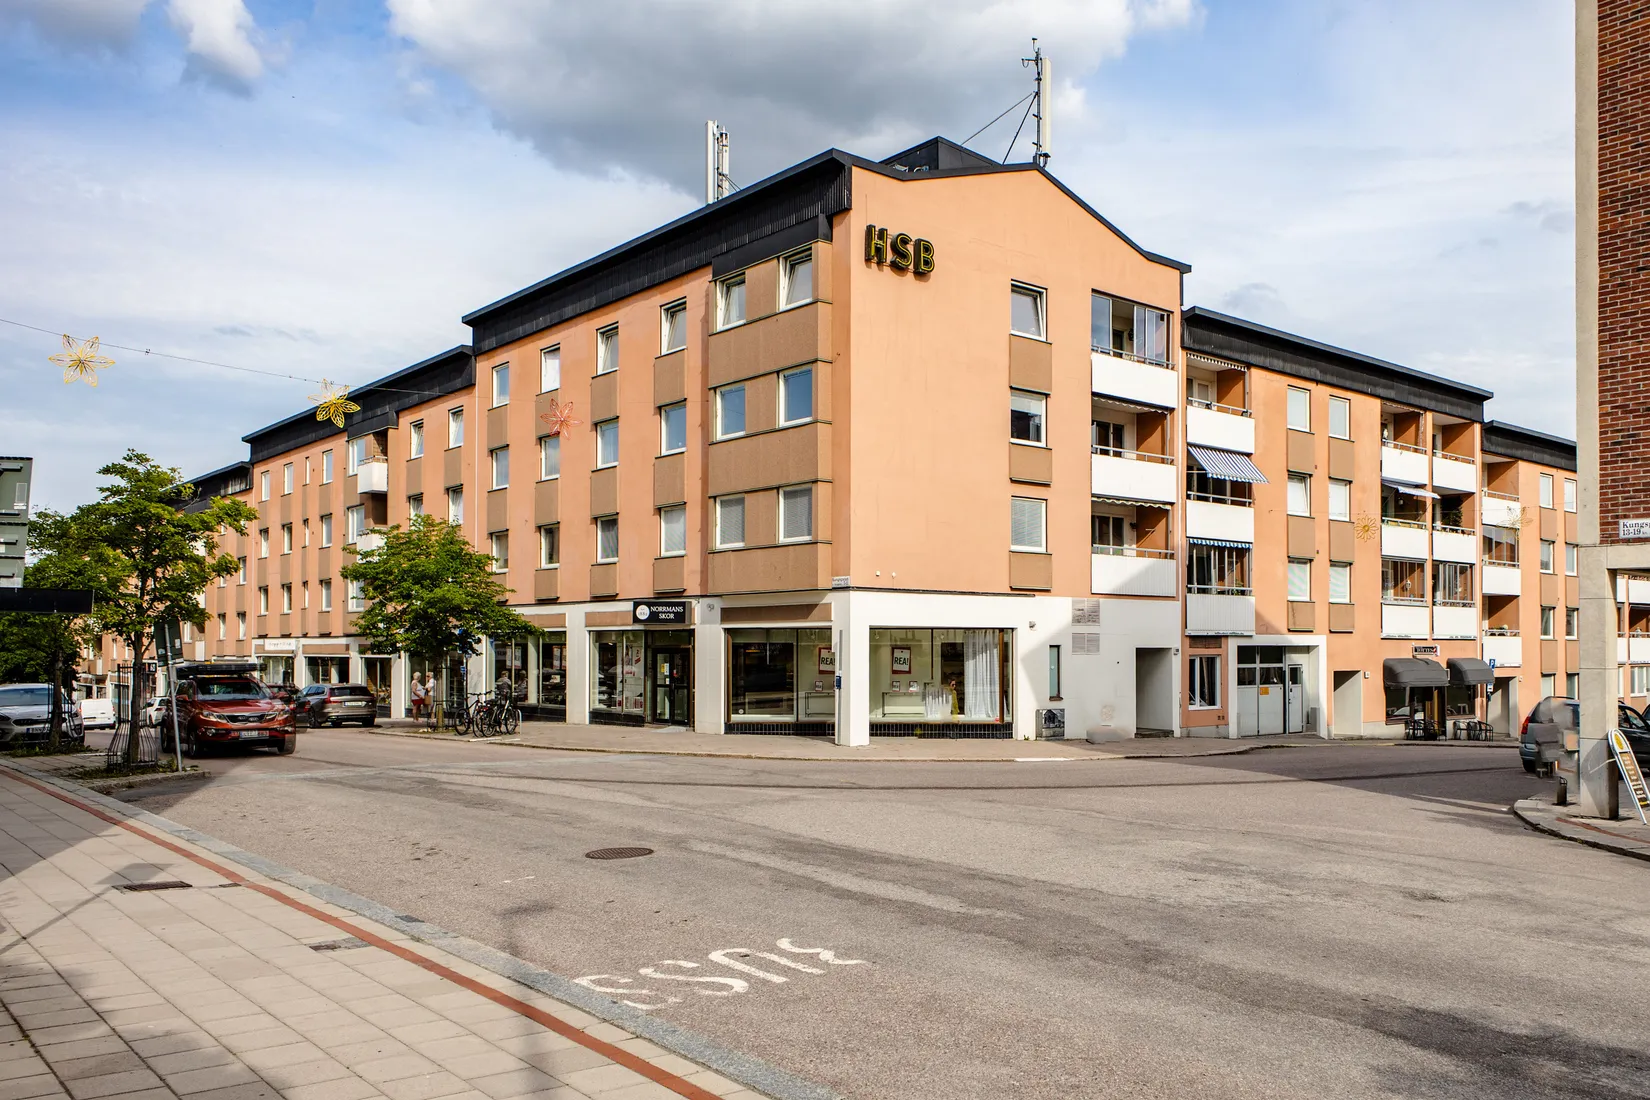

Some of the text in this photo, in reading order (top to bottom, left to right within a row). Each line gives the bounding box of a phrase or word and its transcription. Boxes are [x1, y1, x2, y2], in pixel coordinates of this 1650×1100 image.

[865, 224, 935, 274] HSB
[1622, 528, 1641, 536] 13-19
[820, 656, 835, 665] REA!
[893, 656, 909, 665] REA!
[1490, 659, 1495, 668] P
